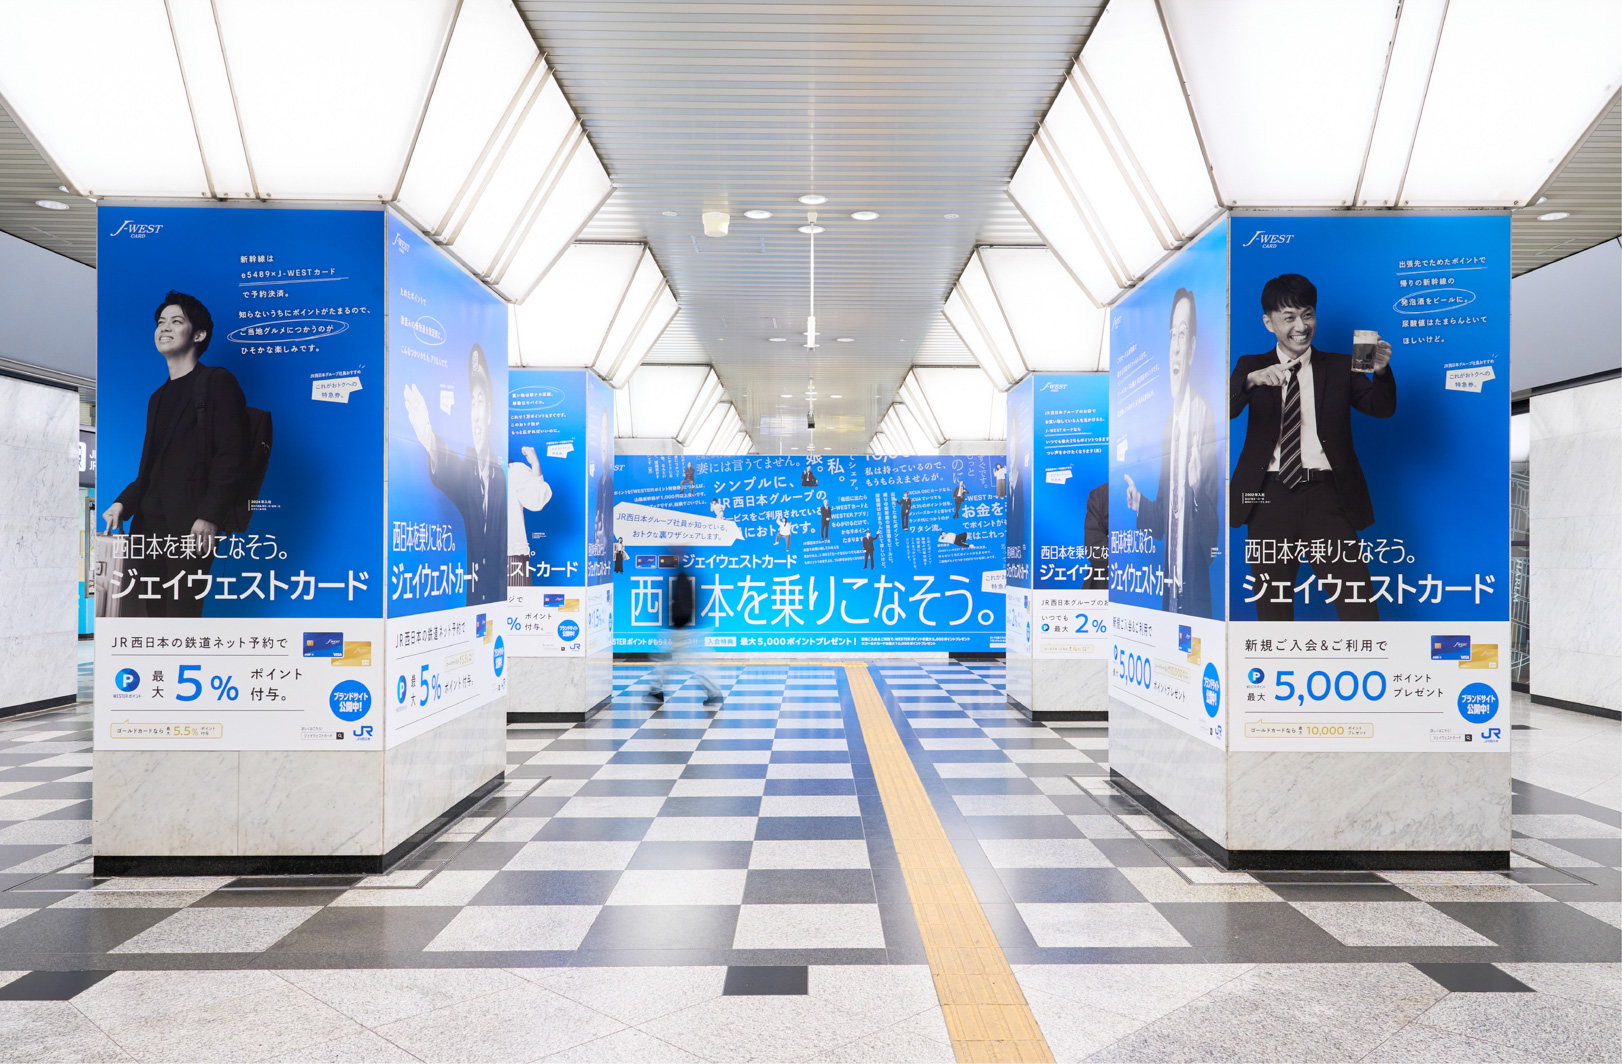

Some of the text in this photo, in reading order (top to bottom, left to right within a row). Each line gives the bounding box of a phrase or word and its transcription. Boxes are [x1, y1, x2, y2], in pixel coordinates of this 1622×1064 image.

[110, 221, 163, 236] J-WEST
[1243, 231, 1294, 247] J-WEST
[240, 255, 274, 263] 新幹線は
[1399, 256, 1486, 268] 出張先でためたポイントで
[1400, 278, 1455, 287] 帰りの新幹線の
[242, 290, 289, 298] で予約決済。
[1401, 296, 1467, 306] 発泡酒をビールに。
[239, 307, 371, 318] 知らないうちにポイントがたまるので、
[1402, 317, 1487, 328] 尿酸値はたまらんといて
[240, 325, 334, 336] ご当地グルメにつかうのが
[1403, 336, 1445, 345] ほしいけど。
[241, 345, 319, 354] ひそかな楽しみです。
[1450, 371, 1490, 379] これがおトクへの
[316, 382, 357, 390] これがおトクへの
[697, 457, 800, 475] 妻には言うてません。
[865, 461, 946, 476] 私は持っているので、
[714, 475, 794, 493] シンプルに、
[723, 507, 822, 522] ービスをご利用されている
[617, 513, 728, 531] JR西日本グループ社員が知っている、
[393, 521, 455, 552] 西日本を乗りこなそう。
[632, 530, 721, 540] おトクな裏ワザシェアします。
[112, 533, 287, 559] 西日本を乗りこなそう。
[1245, 539, 1414, 564] 西日本を乗りこなそう。
[682, 553, 797, 569] ジェイウェストカード
[1040, 564, 1108, 581] ジェイウェ
[110, 569, 369, 601] ジェイウェストカード
[392, 562, 478, 600] ジェイウェストカード
[1243, 573, 1495, 604] ジェイウェストカード
[525, 623, 543, 631] 付与。
[396, 622, 465, 648] JR西日本の鉄道ネット予約で
[112, 637, 287, 648] JR西日本の鉄道ネット予約で
[1245, 639, 1387, 652] 新規ご入会&ご利用で
[251, 669, 302, 680] ポイント
[1120, 650, 1151, 689] 5,000
[1393, 673, 1431, 683] ポイント
[1274, 670, 1387, 706] 5,000
[1394, 688, 1444, 698] プレゼント
[251, 687, 287, 701] 付与。
[334, 692, 368, 700] ブランドサイト
[1247, 693, 1266, 702] 最大
[1461, 695, 1495, 703] ブランドサイト
[353, 726, 373, 736] JR
[1306, 726, 1344, 736] 10,000
[1481, 728, 1501, 739] JR
